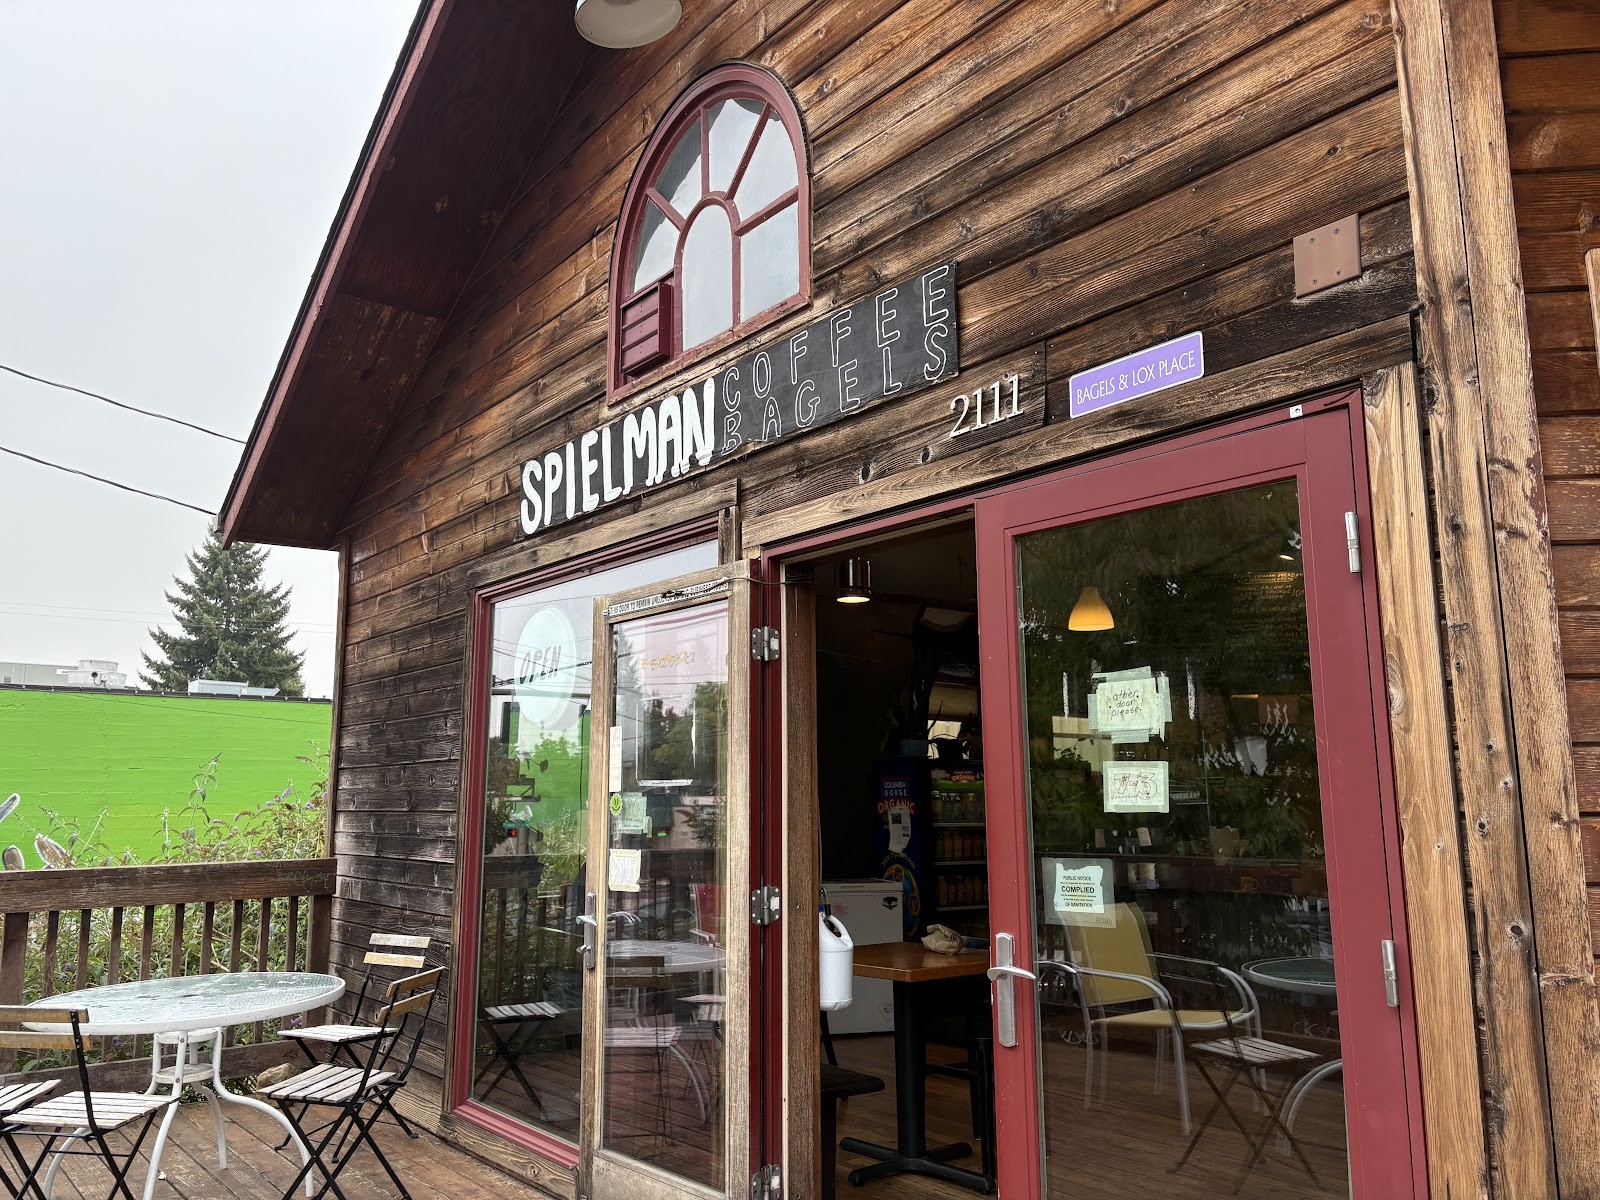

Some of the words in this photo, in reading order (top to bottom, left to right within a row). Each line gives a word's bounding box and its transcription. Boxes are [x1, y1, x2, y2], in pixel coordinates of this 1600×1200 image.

[722, 264, 949, 412] COFFEE
[721, 323, 949, 456] BAGELS
[1076, 376, 1116, 406] BAGELS
[1118, 373, 1129, 391] &
[1132, 363, 1156, 387] LOX
[1158, 350, 1196, 379] PLACE
[949, 373, 1024, 438] 2111
[520, 377, 716, 535] SPIELMAN
[619, 602, 630, 613] DOOR
[630, 601, 636, 611] TO
[636, 597, 651, 609] REMAIN
[519, 645, 562, 685] OPEN
[1112, 689, 1139, 701] other
[1116, 700, 1136, 708] door
[884, 789, 908, 797] GORGE
[1061, 885, 1095, 894] COMPLIED
